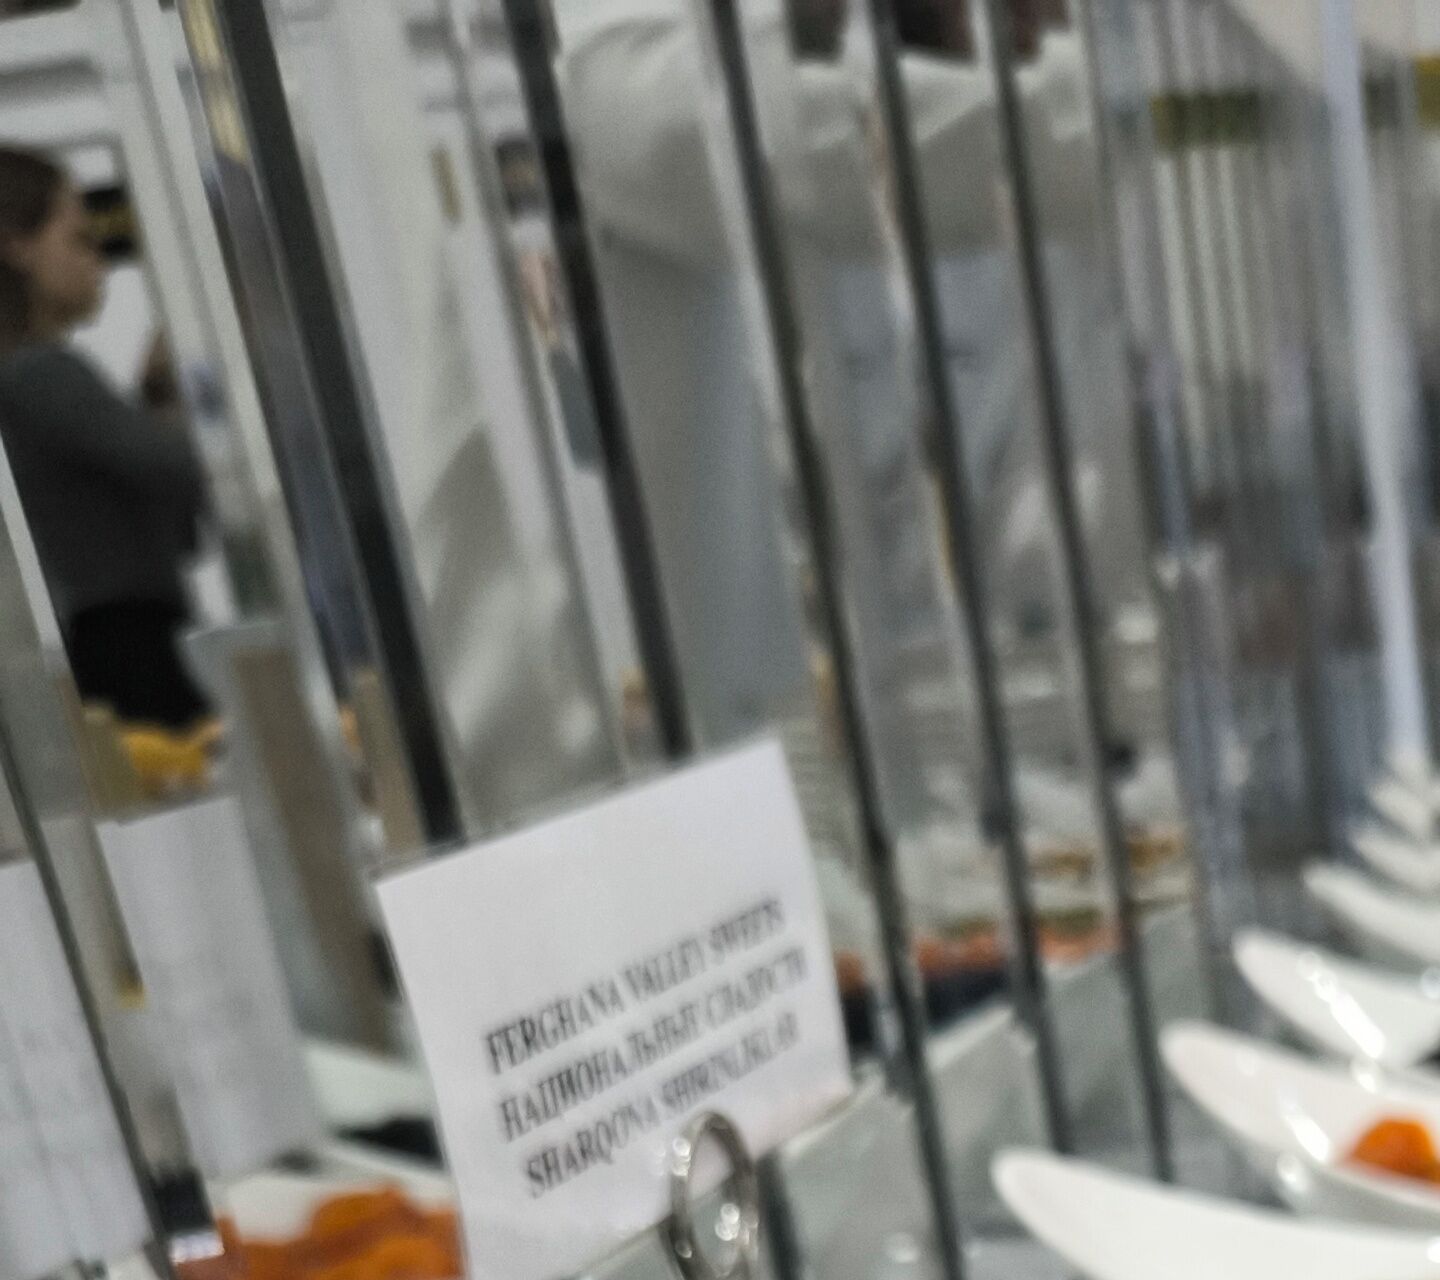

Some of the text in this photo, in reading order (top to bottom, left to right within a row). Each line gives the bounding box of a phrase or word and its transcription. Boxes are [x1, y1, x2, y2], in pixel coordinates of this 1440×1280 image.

[485, 976, 624, 1075] FERGHANA
[622, 935, 706, 1001] VALLEY
[500, 1004, 700, 1143] НАЦИОНАЛЬНЫЕ
[525, 1097, 661, 1199] SHARQONA
